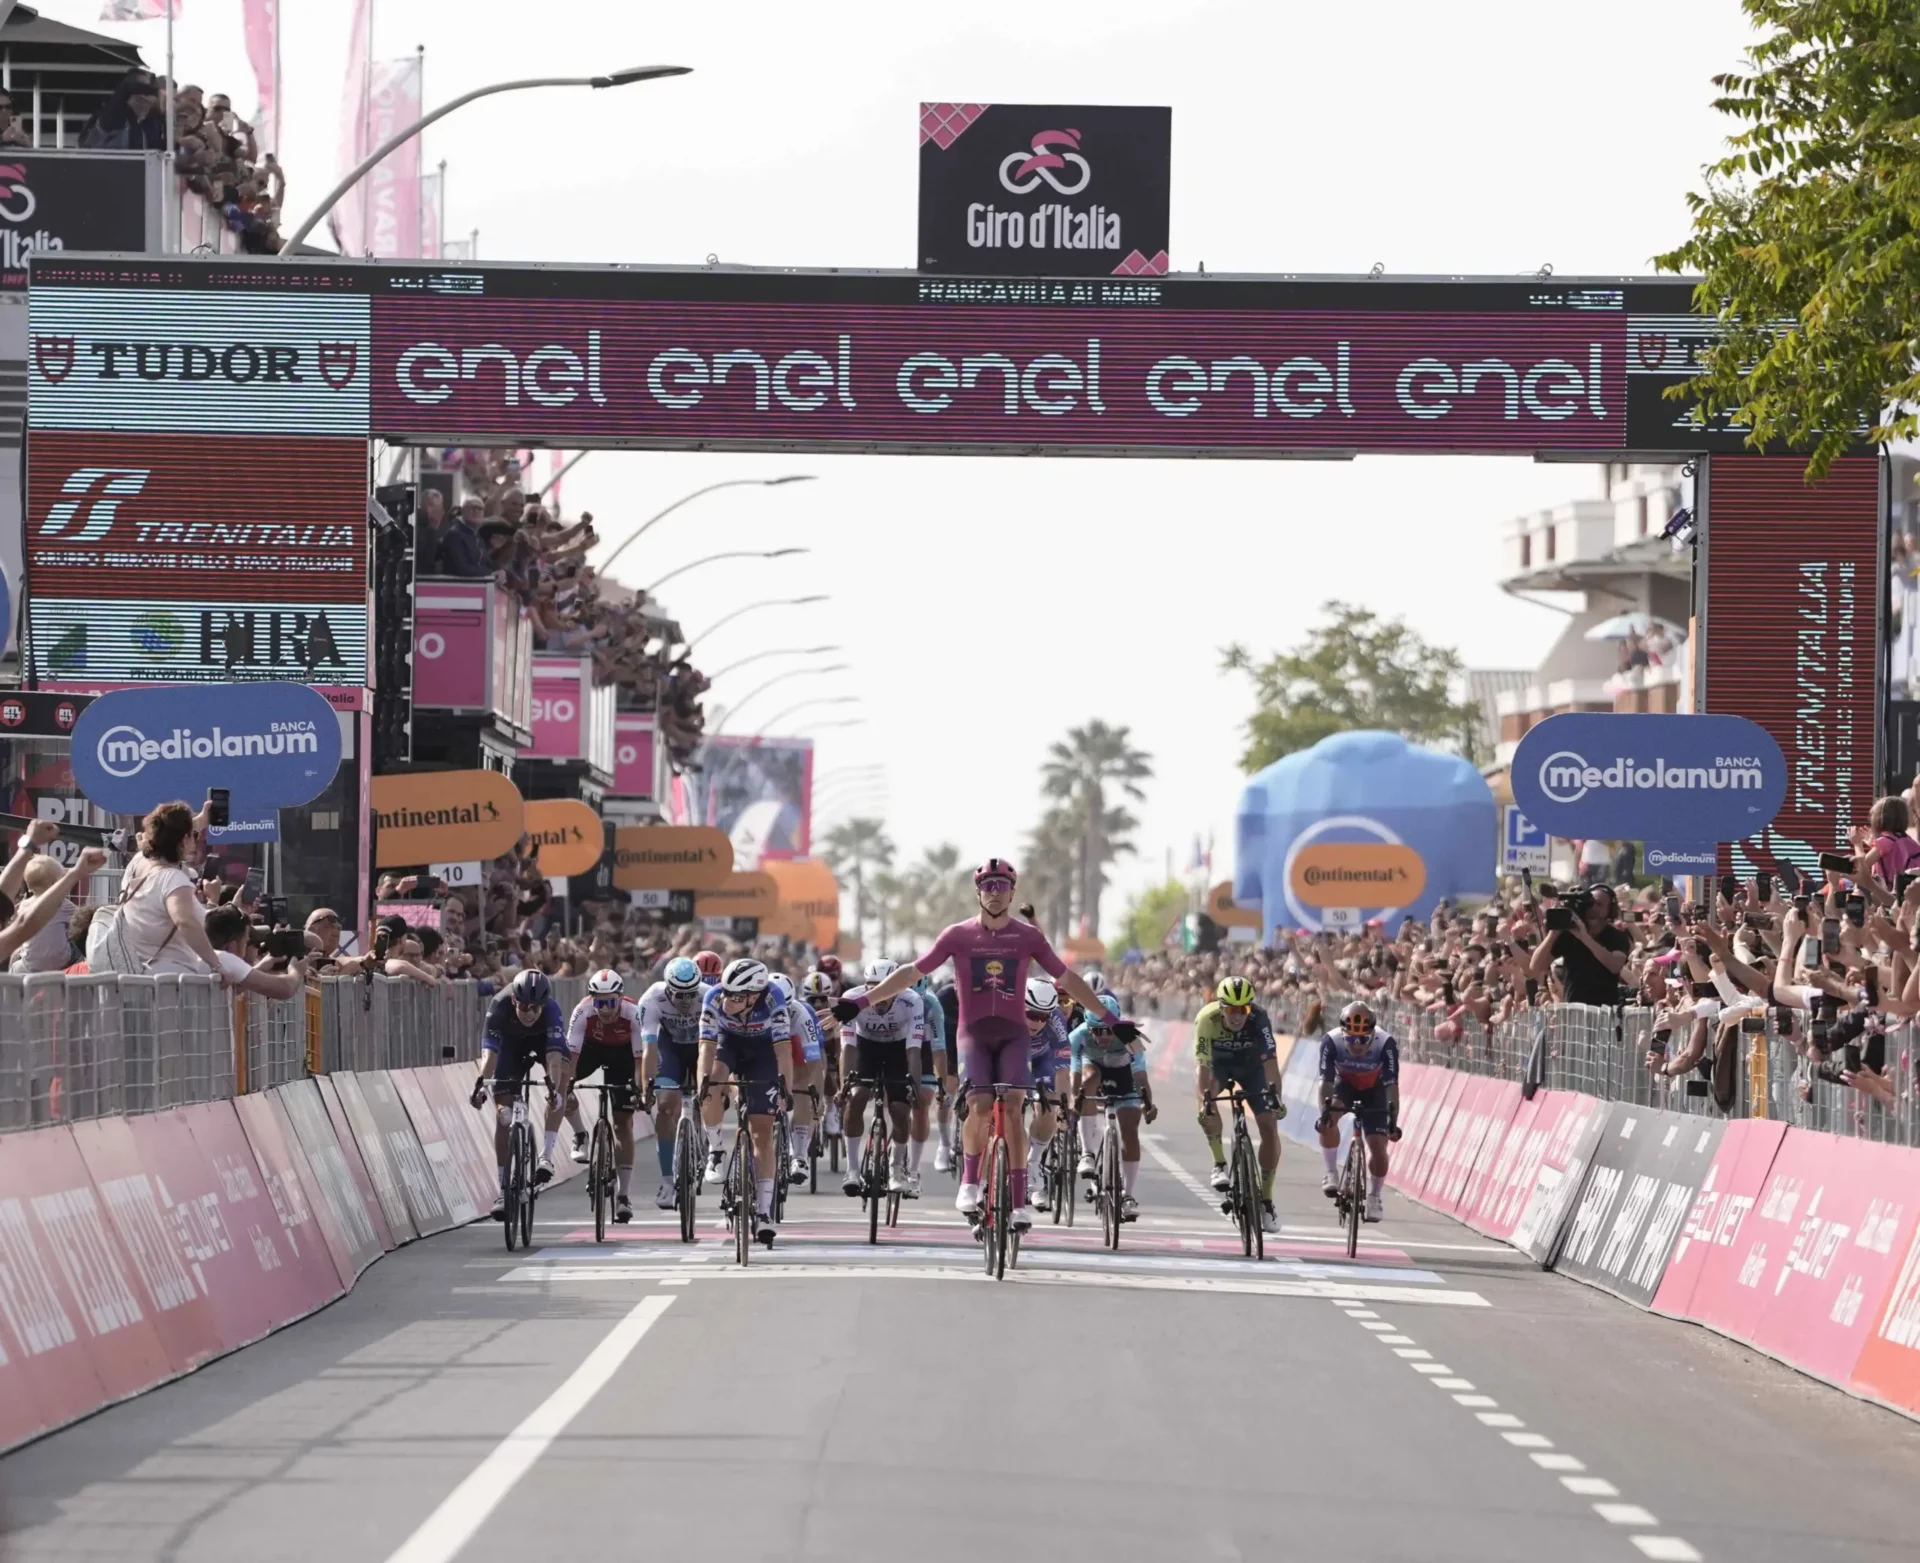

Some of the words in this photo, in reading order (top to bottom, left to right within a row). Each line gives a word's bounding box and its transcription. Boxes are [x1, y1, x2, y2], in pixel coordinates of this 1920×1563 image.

[967, 202, 1024, 248] Giro
[1029, 203, 1120, 249] d'Italia
[90, 341, 303, 383] TUDOR
[396, 330, 607, 407] enel
[647, 335, 857, 411] enel
[897, 339, 1106, 415] enel
[1145, 341, 1356, 418] enel
[1396, 343, 1607, 420] enel
[135, 522, 354, 546] TRENITALIA
[1795, 562, 1828, 813] TRENITALIA
[3, 706, 21, 714] RTL
[59, 708, 73, 717] RTL
[270, 721, 316, 732] BANCA
[106, 727, 318, 764] mediolanum
[1715, 756, 1761, 767] BANCA
[1549, 758, 1763, 790] mediolanum
[615, 849, 703, 868] Continental
[1651, 852, 1716, 864] mediolanum
[442, 867, 463, 882] 10
[1303, 867, 1394, 886] Continental
[642, 894, 657, 905] 50
[1332, 911, 1347, 921] 50
[865, 1022, 898, 1031] UAE
[1261, 1027, 1276, 1050] BORA
